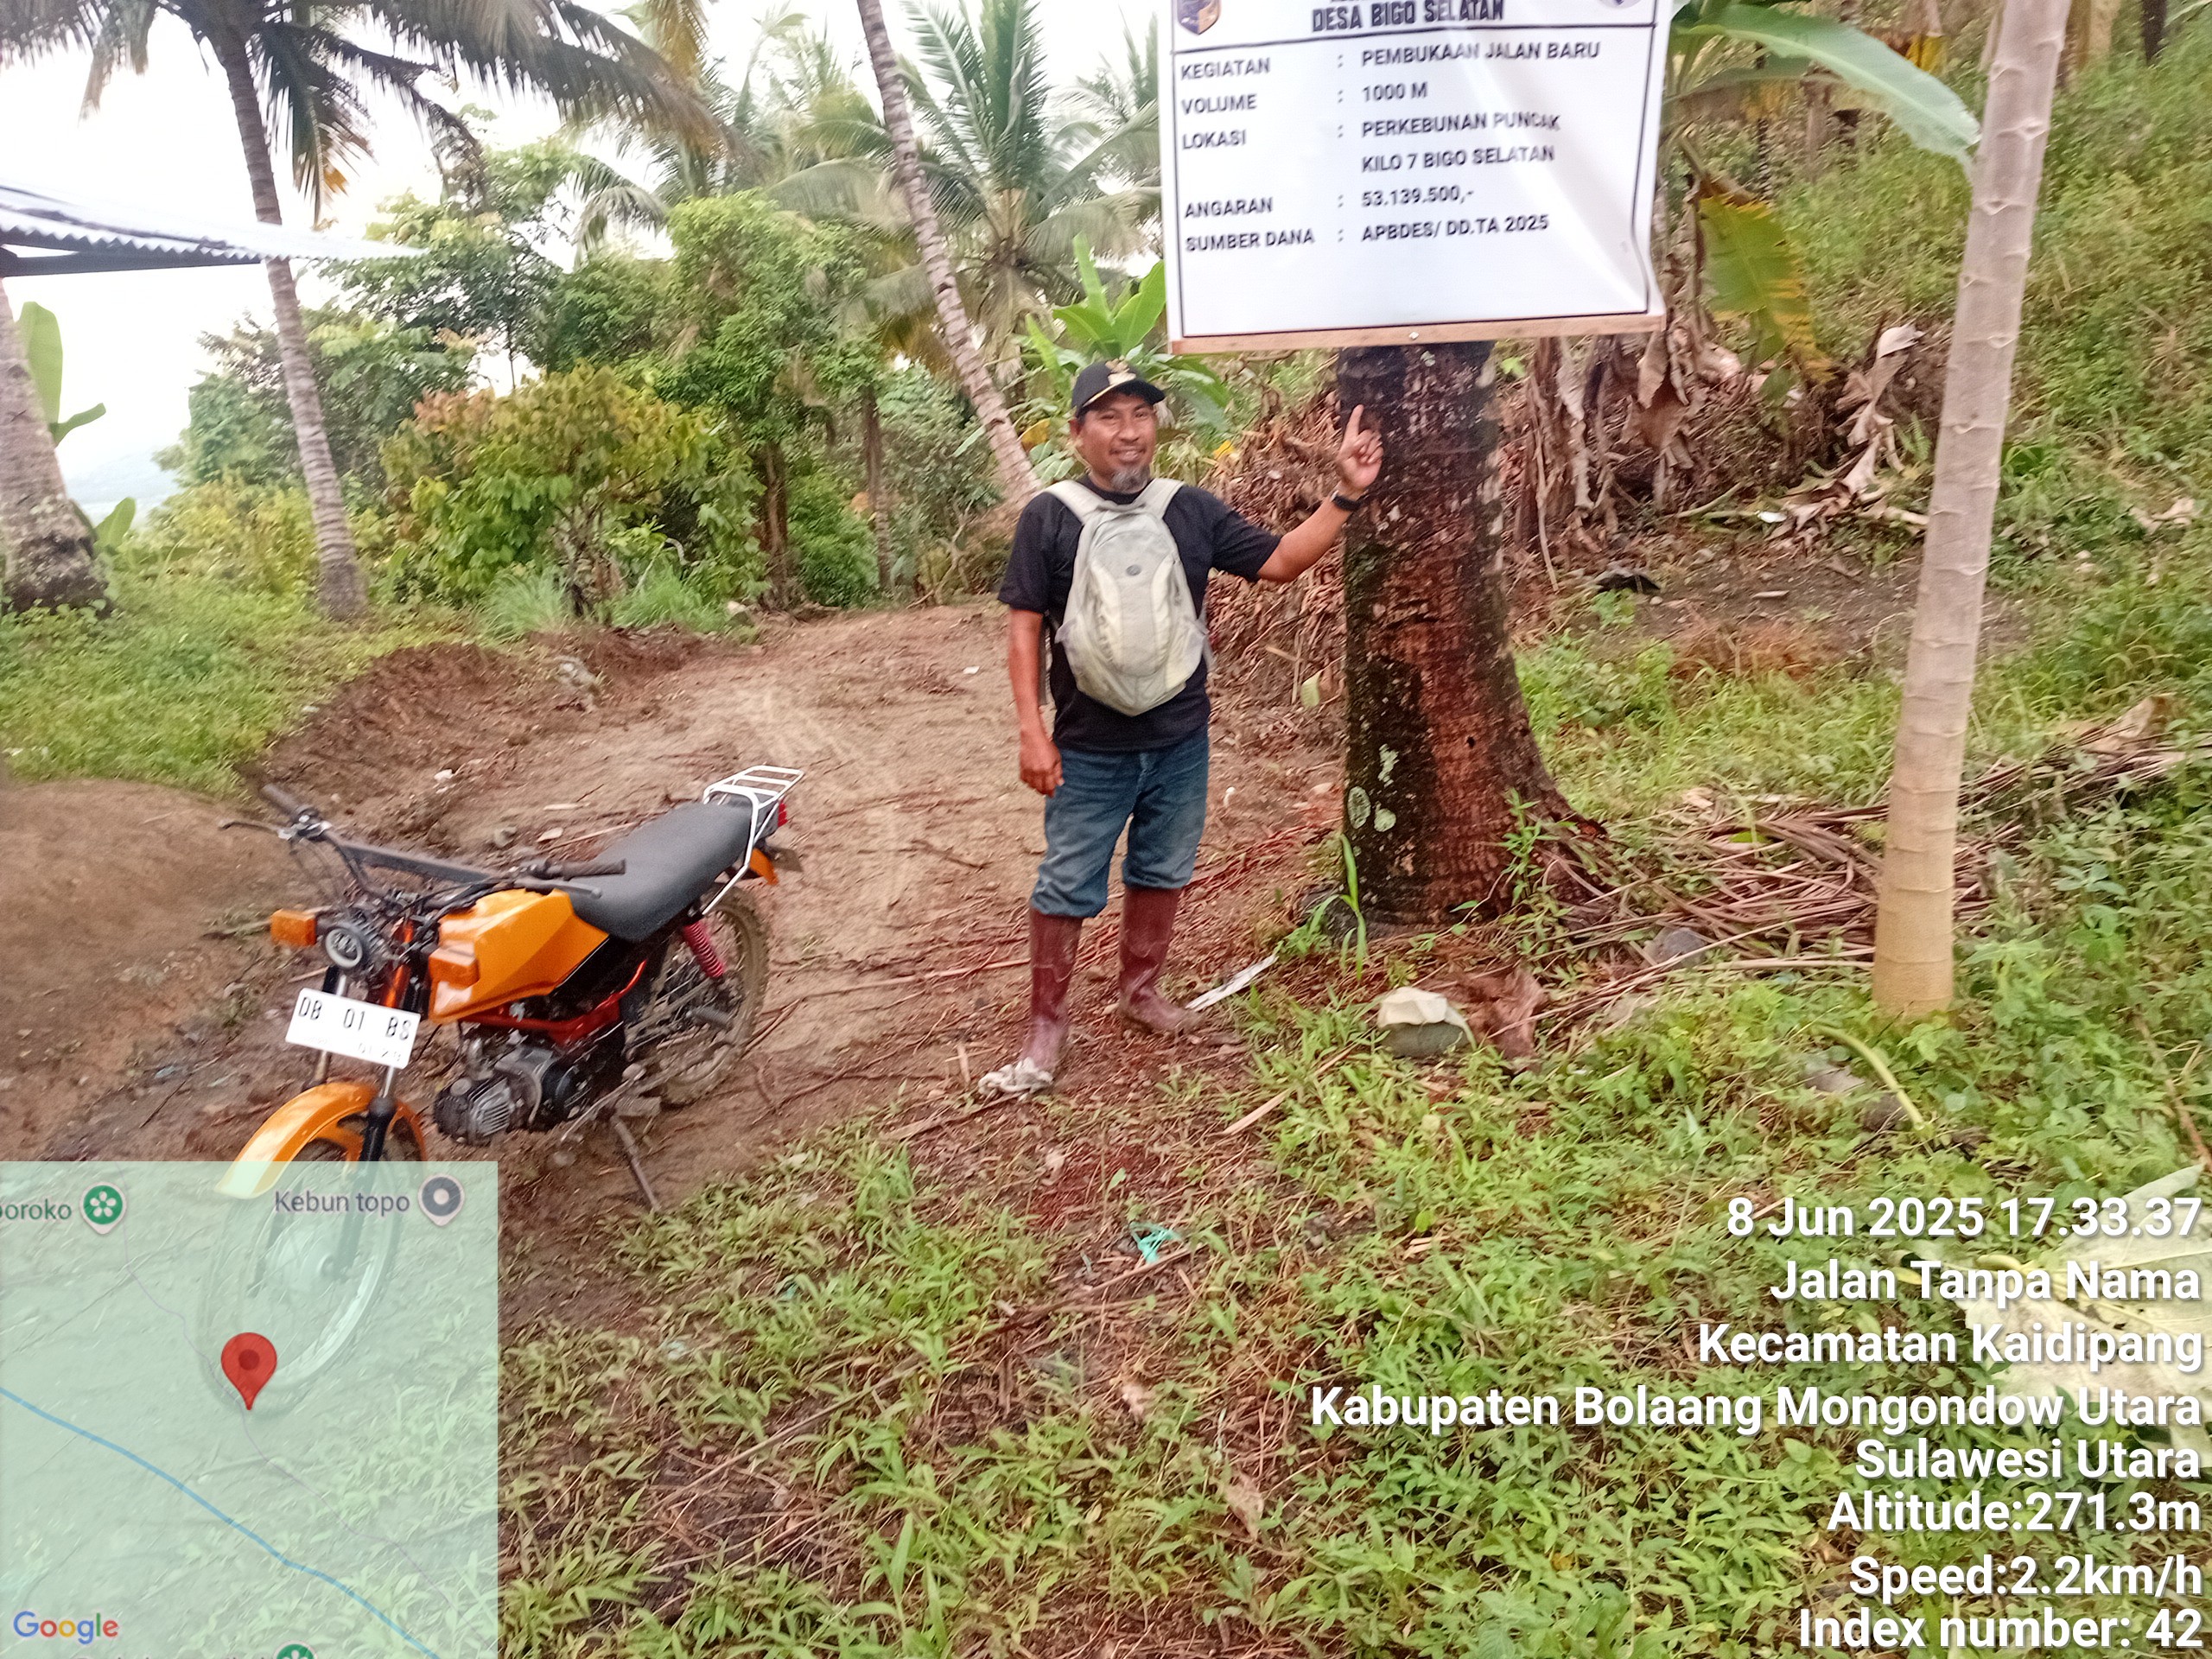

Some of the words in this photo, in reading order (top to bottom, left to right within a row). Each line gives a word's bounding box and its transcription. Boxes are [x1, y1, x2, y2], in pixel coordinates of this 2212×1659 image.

[1313, 5, 1363, 32] DESA
[1371, 0, 1415, 27] BIGO
[1424, 0, 1503, 22] SELATAN
[1180, 57, 1271, 80] KEGIATAN
[1361, 43, 1479, 67] PEMBUKAAN
[1485, 42, 1541, 60] JALAN
[1547, 41, 1601, 60] BARU
[1181, 93, 1257, 115] VOLUME
[1362, 84, 1406, 102] 1000
[1411, 81, 1428, 99] M
[1182, 130, 1247, 149] LOKASI
[1362, 112, 1487, 137] PERKEBUNAN
[1361, 154, 1402, 173] KILO
[1408, 153, 1419, 170] 7
[1424, 149, 1467, 168] BIGO
[1473, 145, 1556, 164] SELATAN
[1185, 196, 1274, 219] ANGARAN
[1186, 232, 1261, 251] SUMBER
[1266, 228, 1316, 246] DANA
[1361, 221, 1441, 242] APBDES/
[1446, 218, 1499, 236] DD.TA
[1504, 214, 1550, 232] 2025
